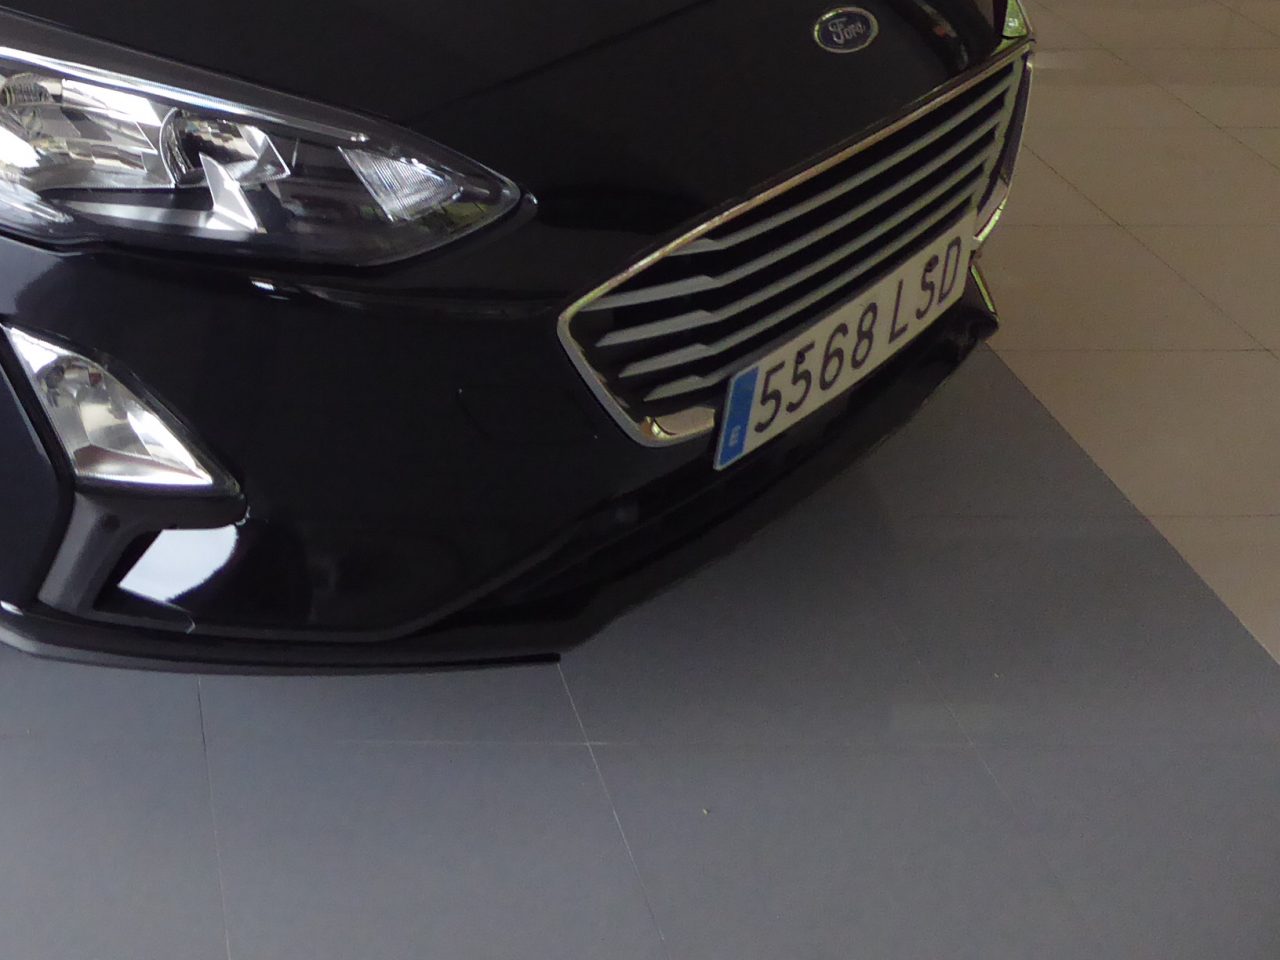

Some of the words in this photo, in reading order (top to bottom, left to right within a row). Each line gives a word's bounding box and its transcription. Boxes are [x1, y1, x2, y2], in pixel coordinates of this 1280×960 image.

[827, 17, 867, 45] Ford
[753, 301, 879, 434] 5568
[888, 235, 962, 345] LSD
